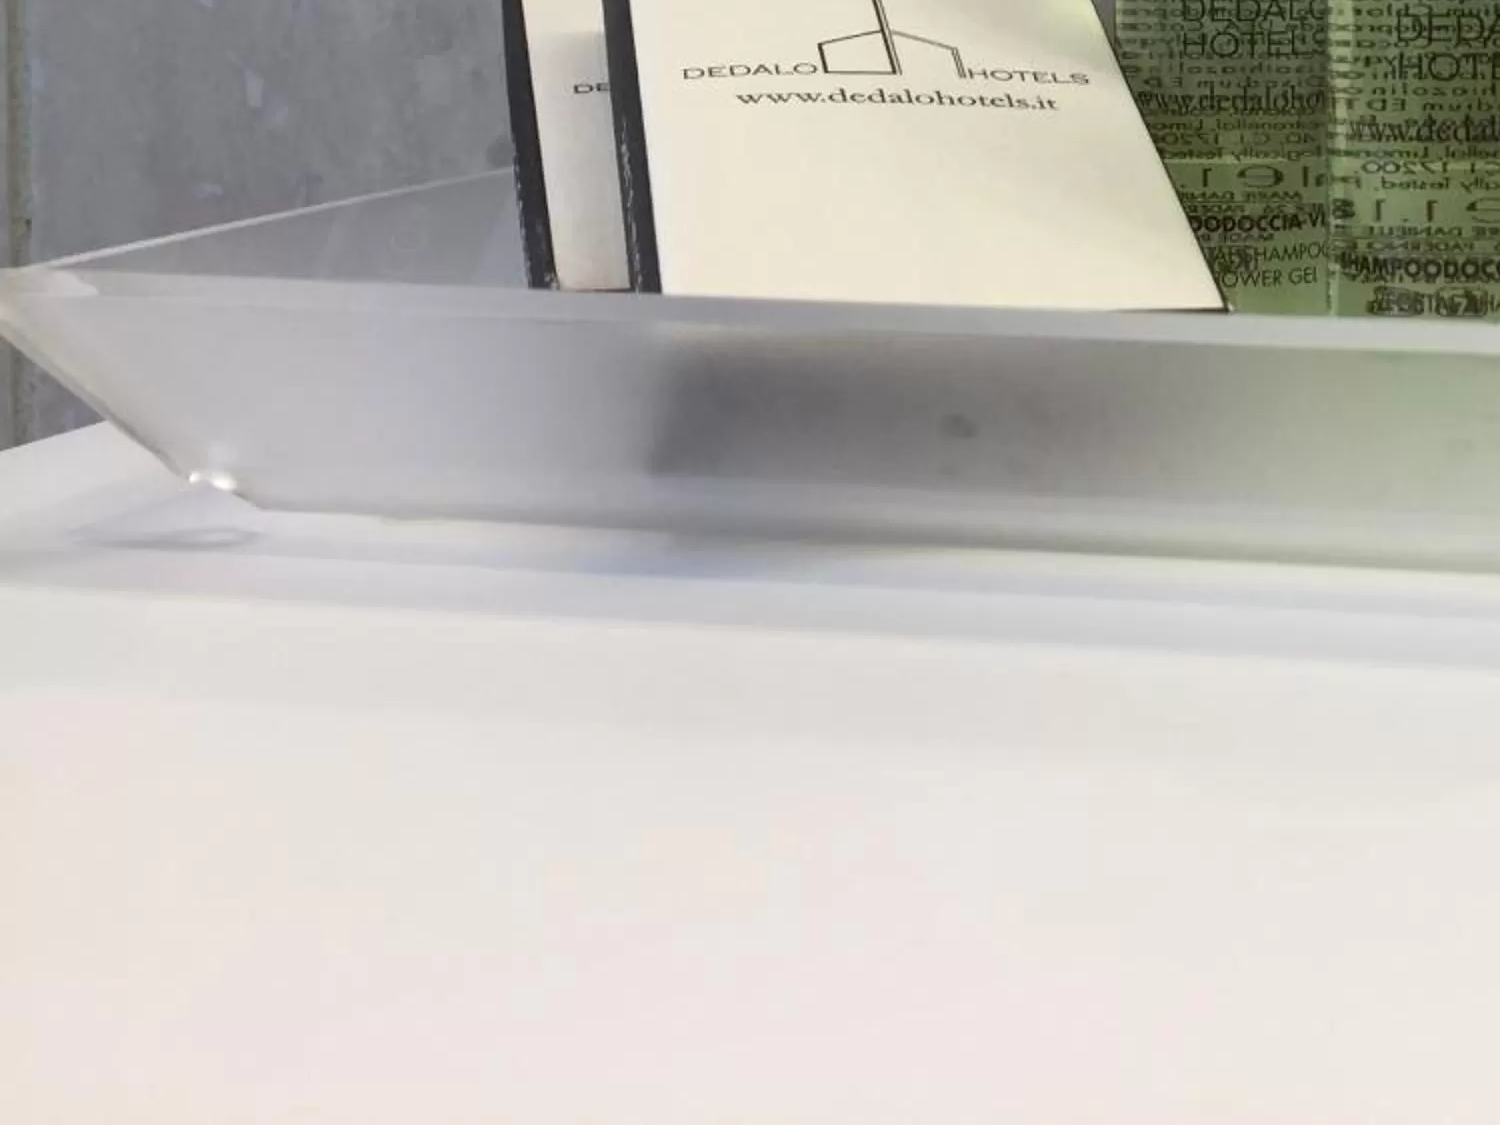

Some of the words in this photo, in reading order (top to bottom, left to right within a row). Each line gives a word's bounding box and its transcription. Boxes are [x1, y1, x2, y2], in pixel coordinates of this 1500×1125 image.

[682, 62, 817, 80] DEDALO
[968, 68, 1089, 85] HOTELS
[736, 87, 1059, 111] www.dedalohotels.it
